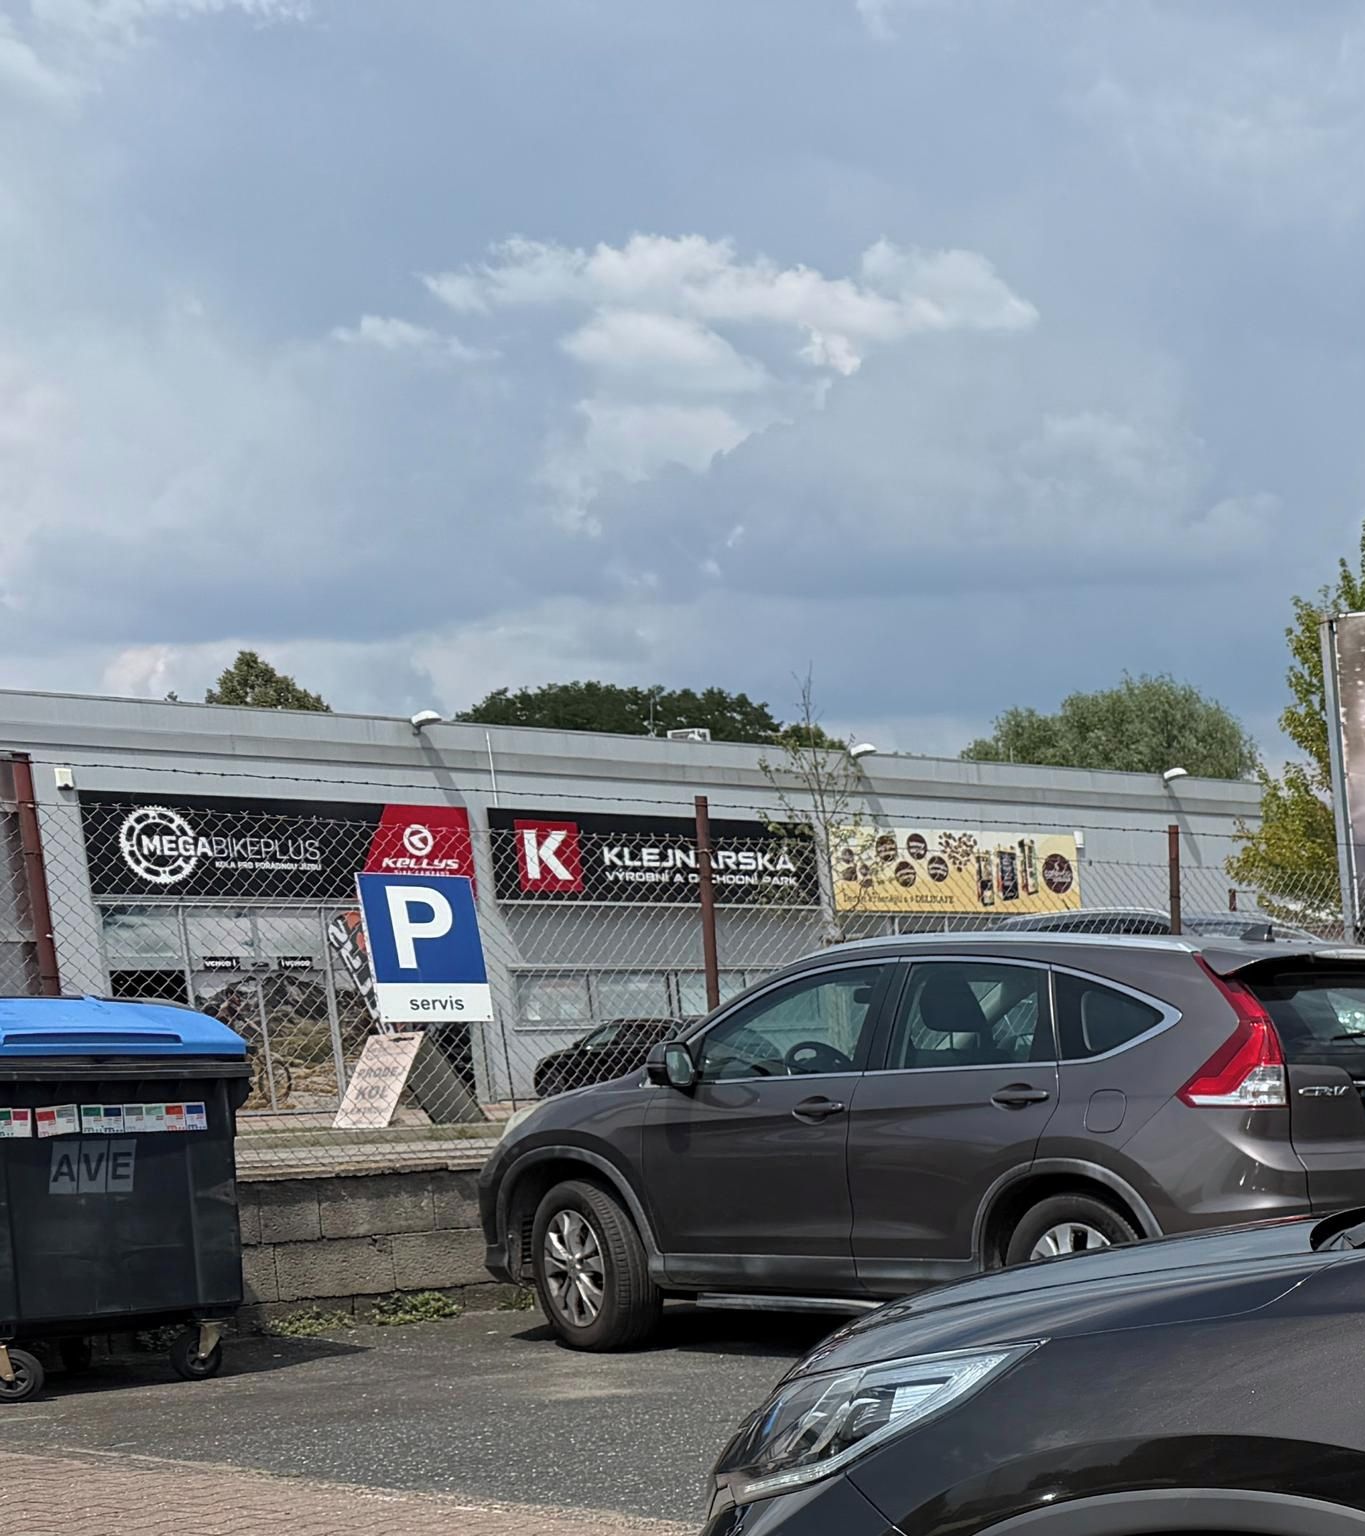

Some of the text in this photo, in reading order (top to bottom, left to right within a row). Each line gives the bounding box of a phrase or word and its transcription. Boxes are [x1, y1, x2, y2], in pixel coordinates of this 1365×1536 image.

[141, 834, 322, 861] MEGABIKEPLUS
[605, 868, 671, 884] VÝROBNÍ
[674, 872, 685, 884] A
[763, 874, 797, 887] PARK
[384, 885, 454, 969] P
[409, 995, 465, 1011] servis
[51, 1152, 132, 1183] AVE
